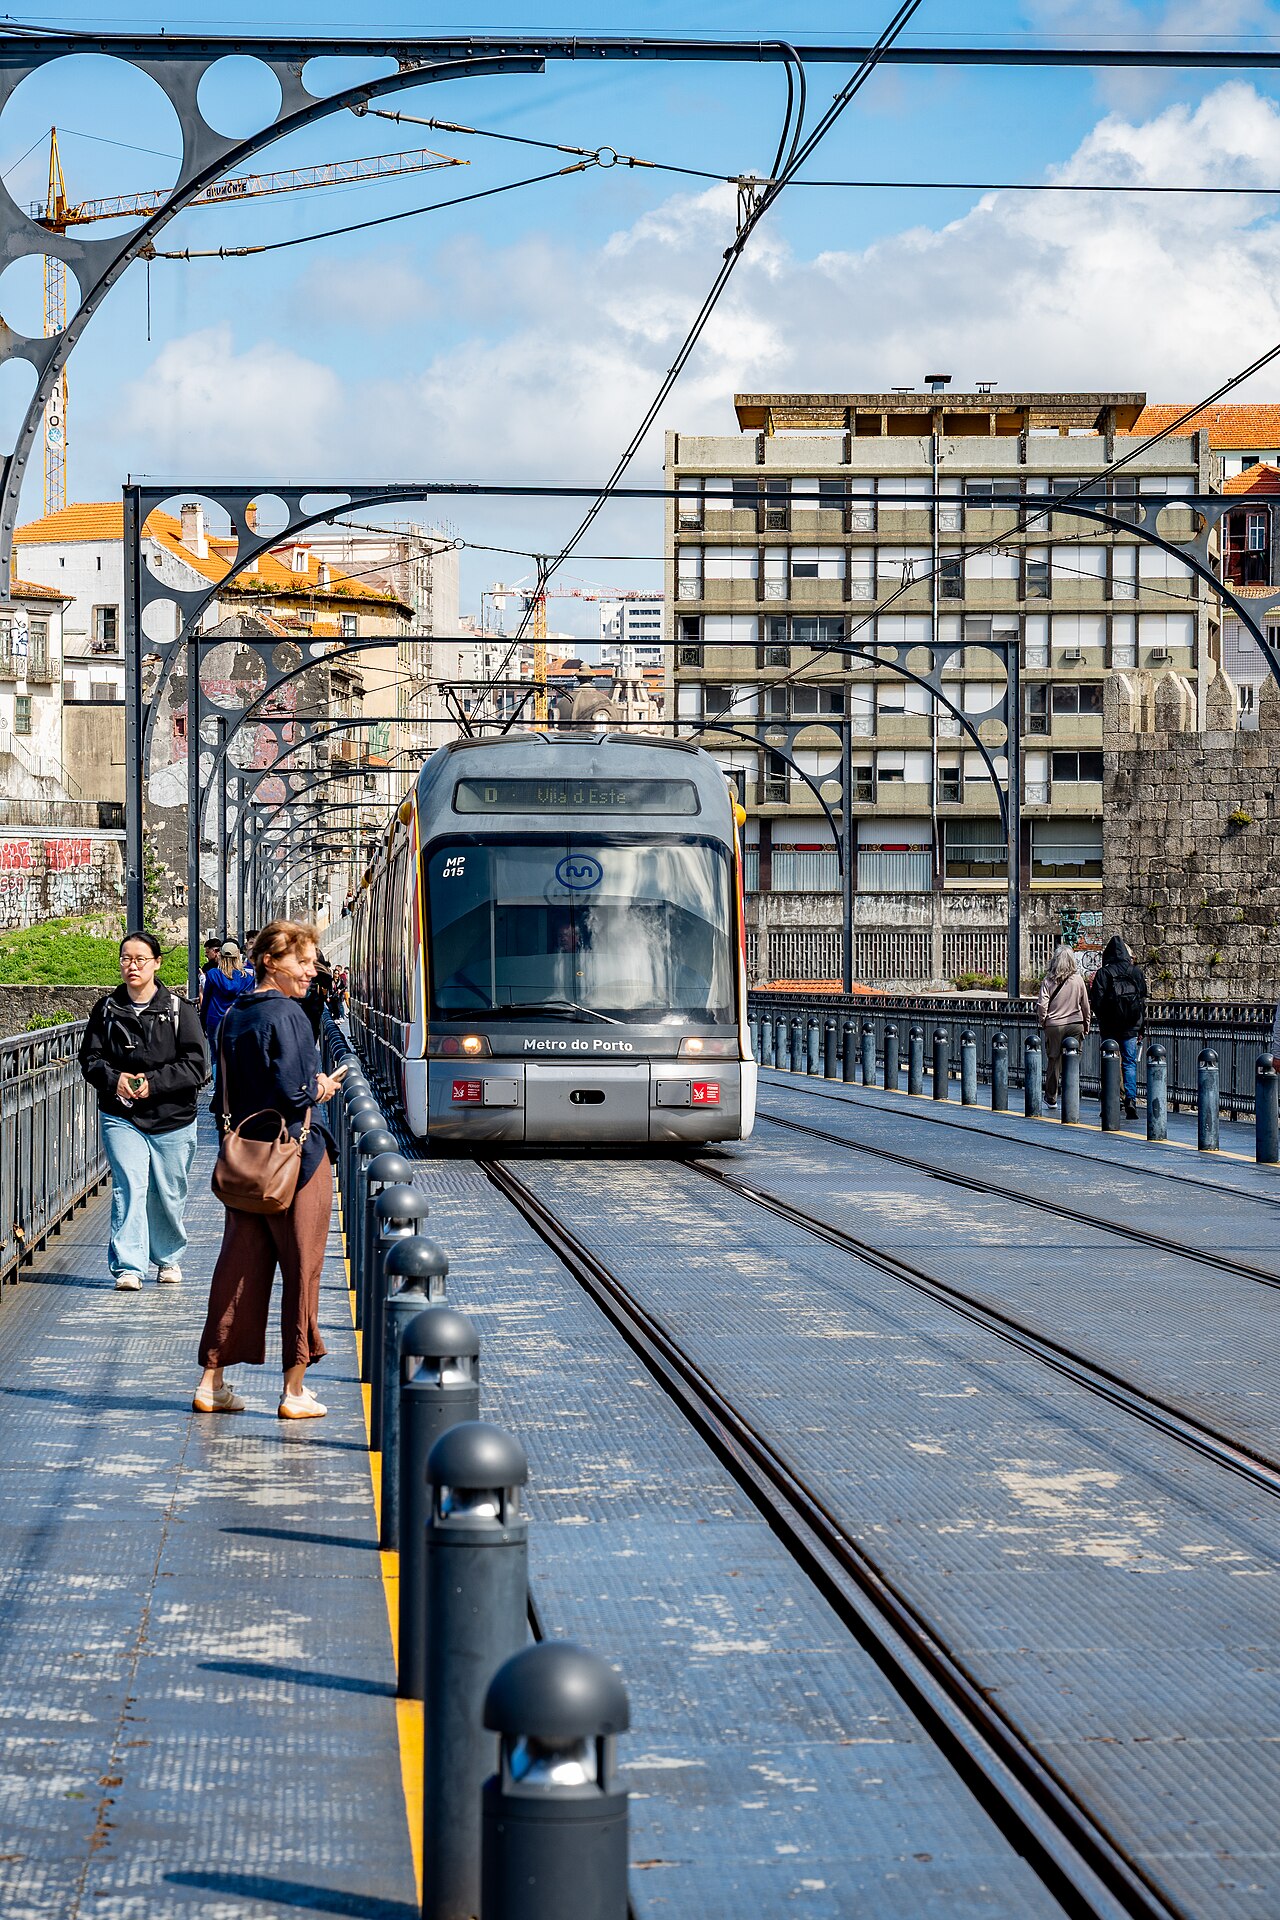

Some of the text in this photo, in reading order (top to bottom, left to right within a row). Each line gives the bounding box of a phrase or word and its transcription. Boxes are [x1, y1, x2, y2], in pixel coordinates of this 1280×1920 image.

[485, 787, 498, 803] D
[446, 856, 466, 867] MP
[442, 866, 465, 878] 015
[523, 1039, 633, 1051] Metro do Porto
